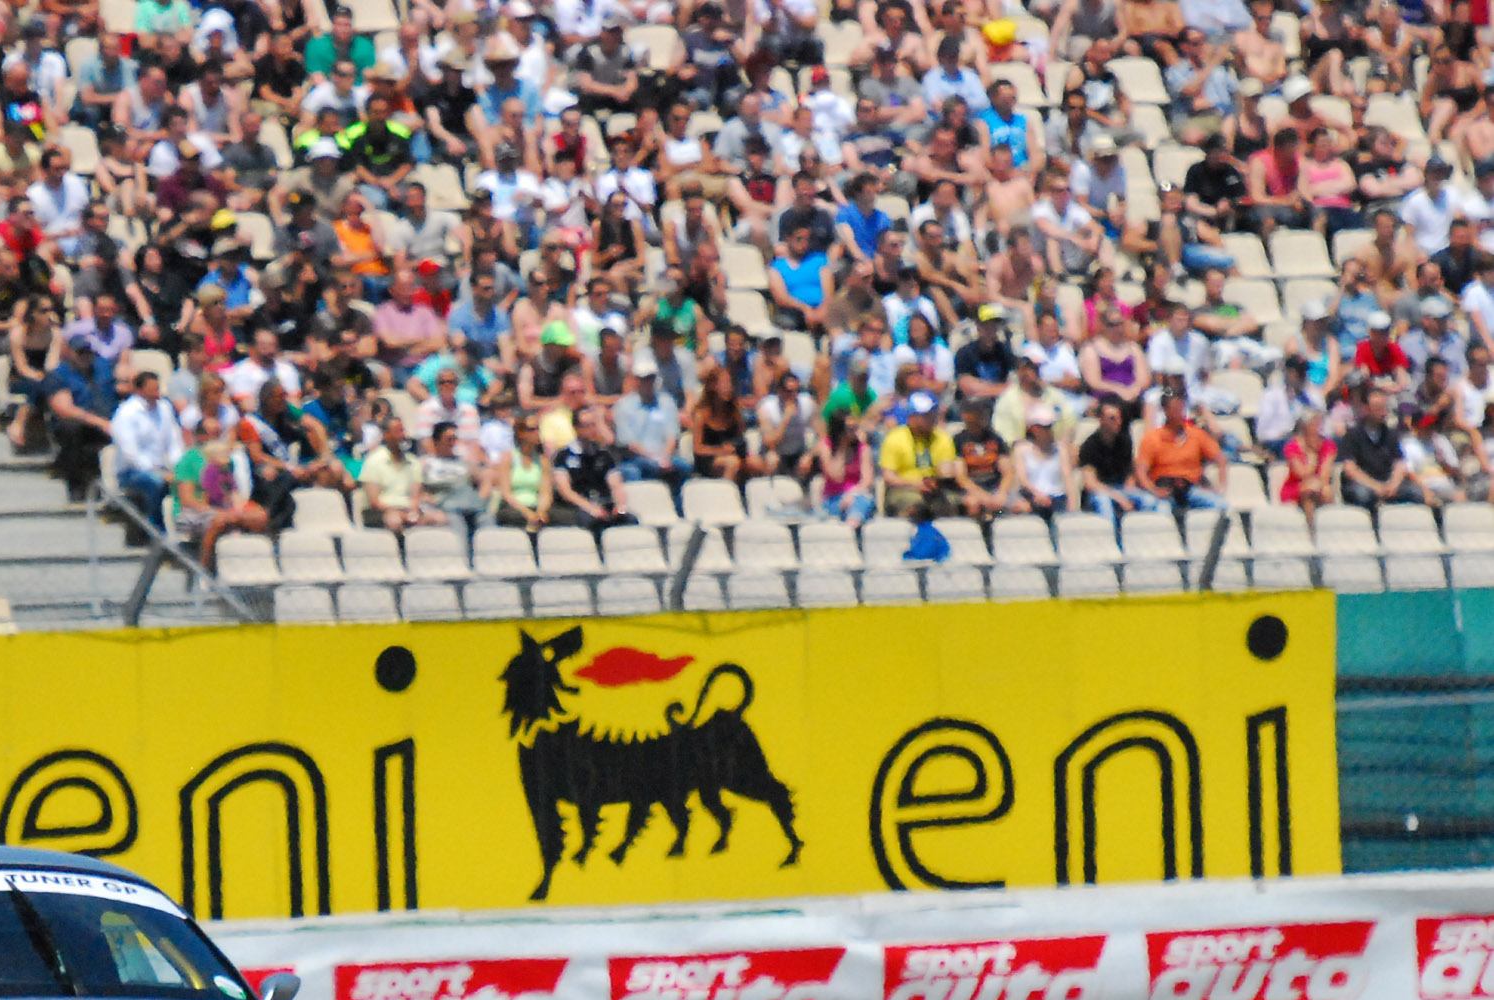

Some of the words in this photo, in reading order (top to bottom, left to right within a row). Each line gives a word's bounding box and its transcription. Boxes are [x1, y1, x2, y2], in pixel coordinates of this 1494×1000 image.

[868, 615, 1293, 892] eni
[6, 874, 91, 888] TUNER
[102, 881, 138, 895] GP
[904, 942, 1017, 983] sport
[1166, 927, 1285, 967] sport
[351, 963, 474, 1000] sport
[626, 955, 751, 993] sport
